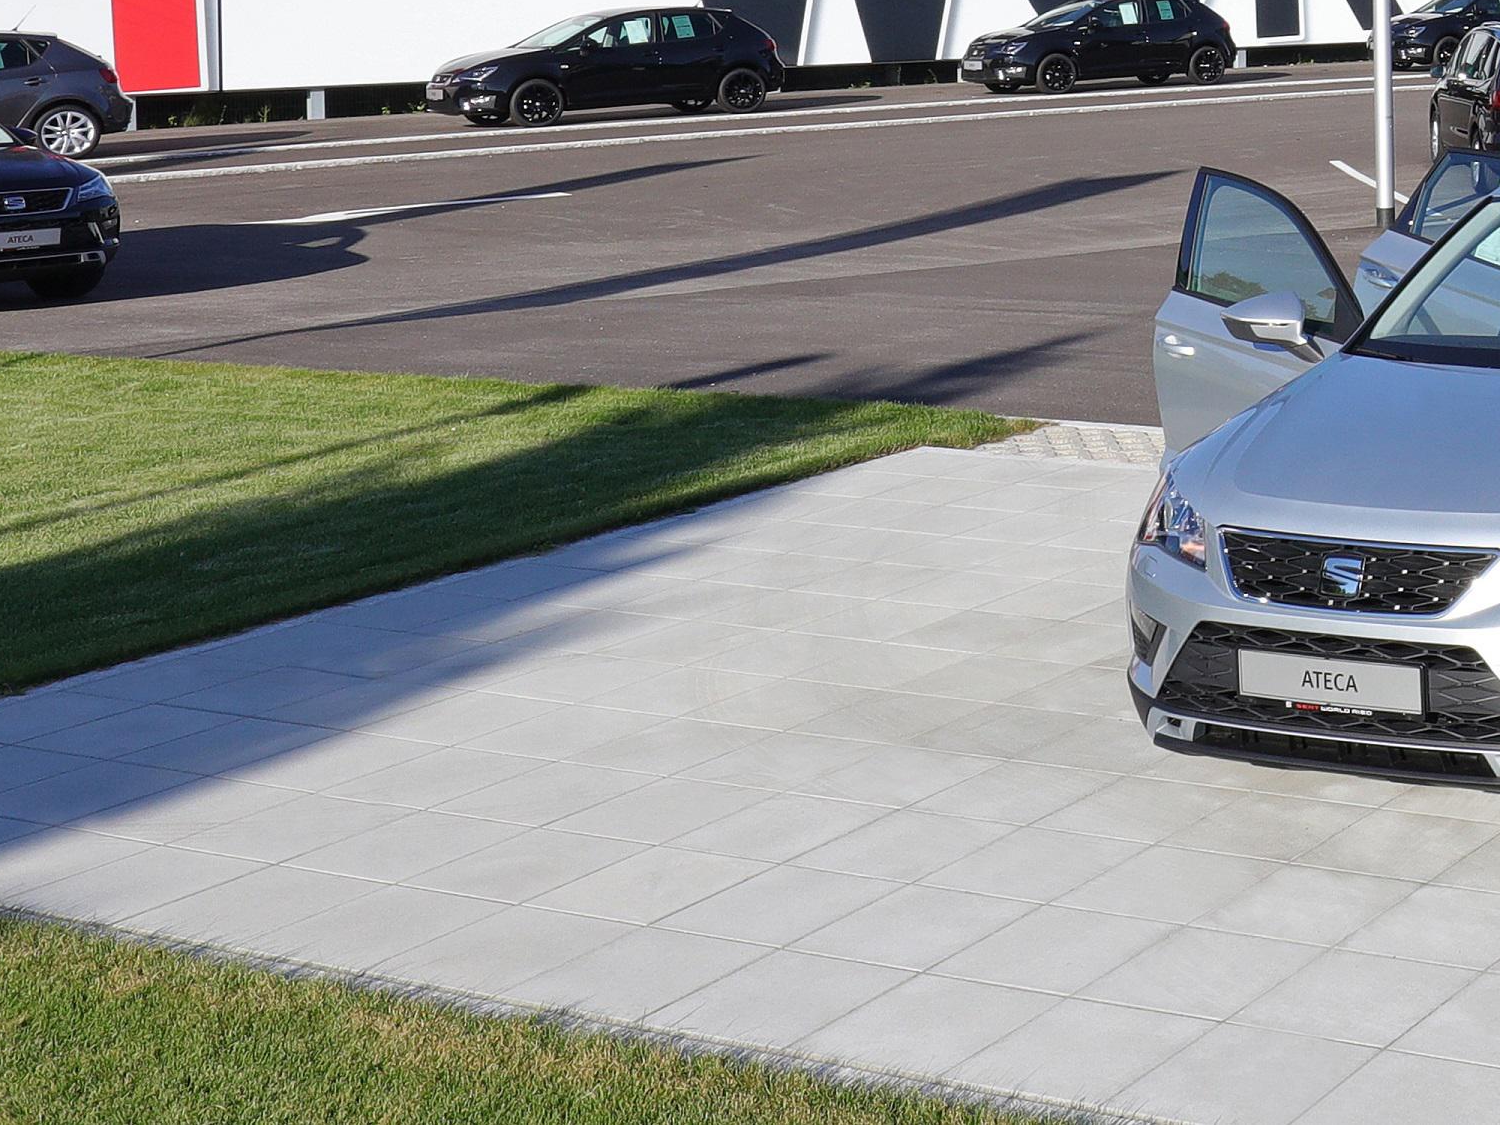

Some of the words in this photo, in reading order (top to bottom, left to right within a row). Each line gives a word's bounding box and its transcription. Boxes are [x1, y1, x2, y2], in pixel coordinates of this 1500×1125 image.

[7, 235, 34, 244] ATECA
[1301, 670, 1358, 693] ATECA
[1295, 702, 1319, 712] SEAT
[1320, 705, 1350, 714] WORLD
